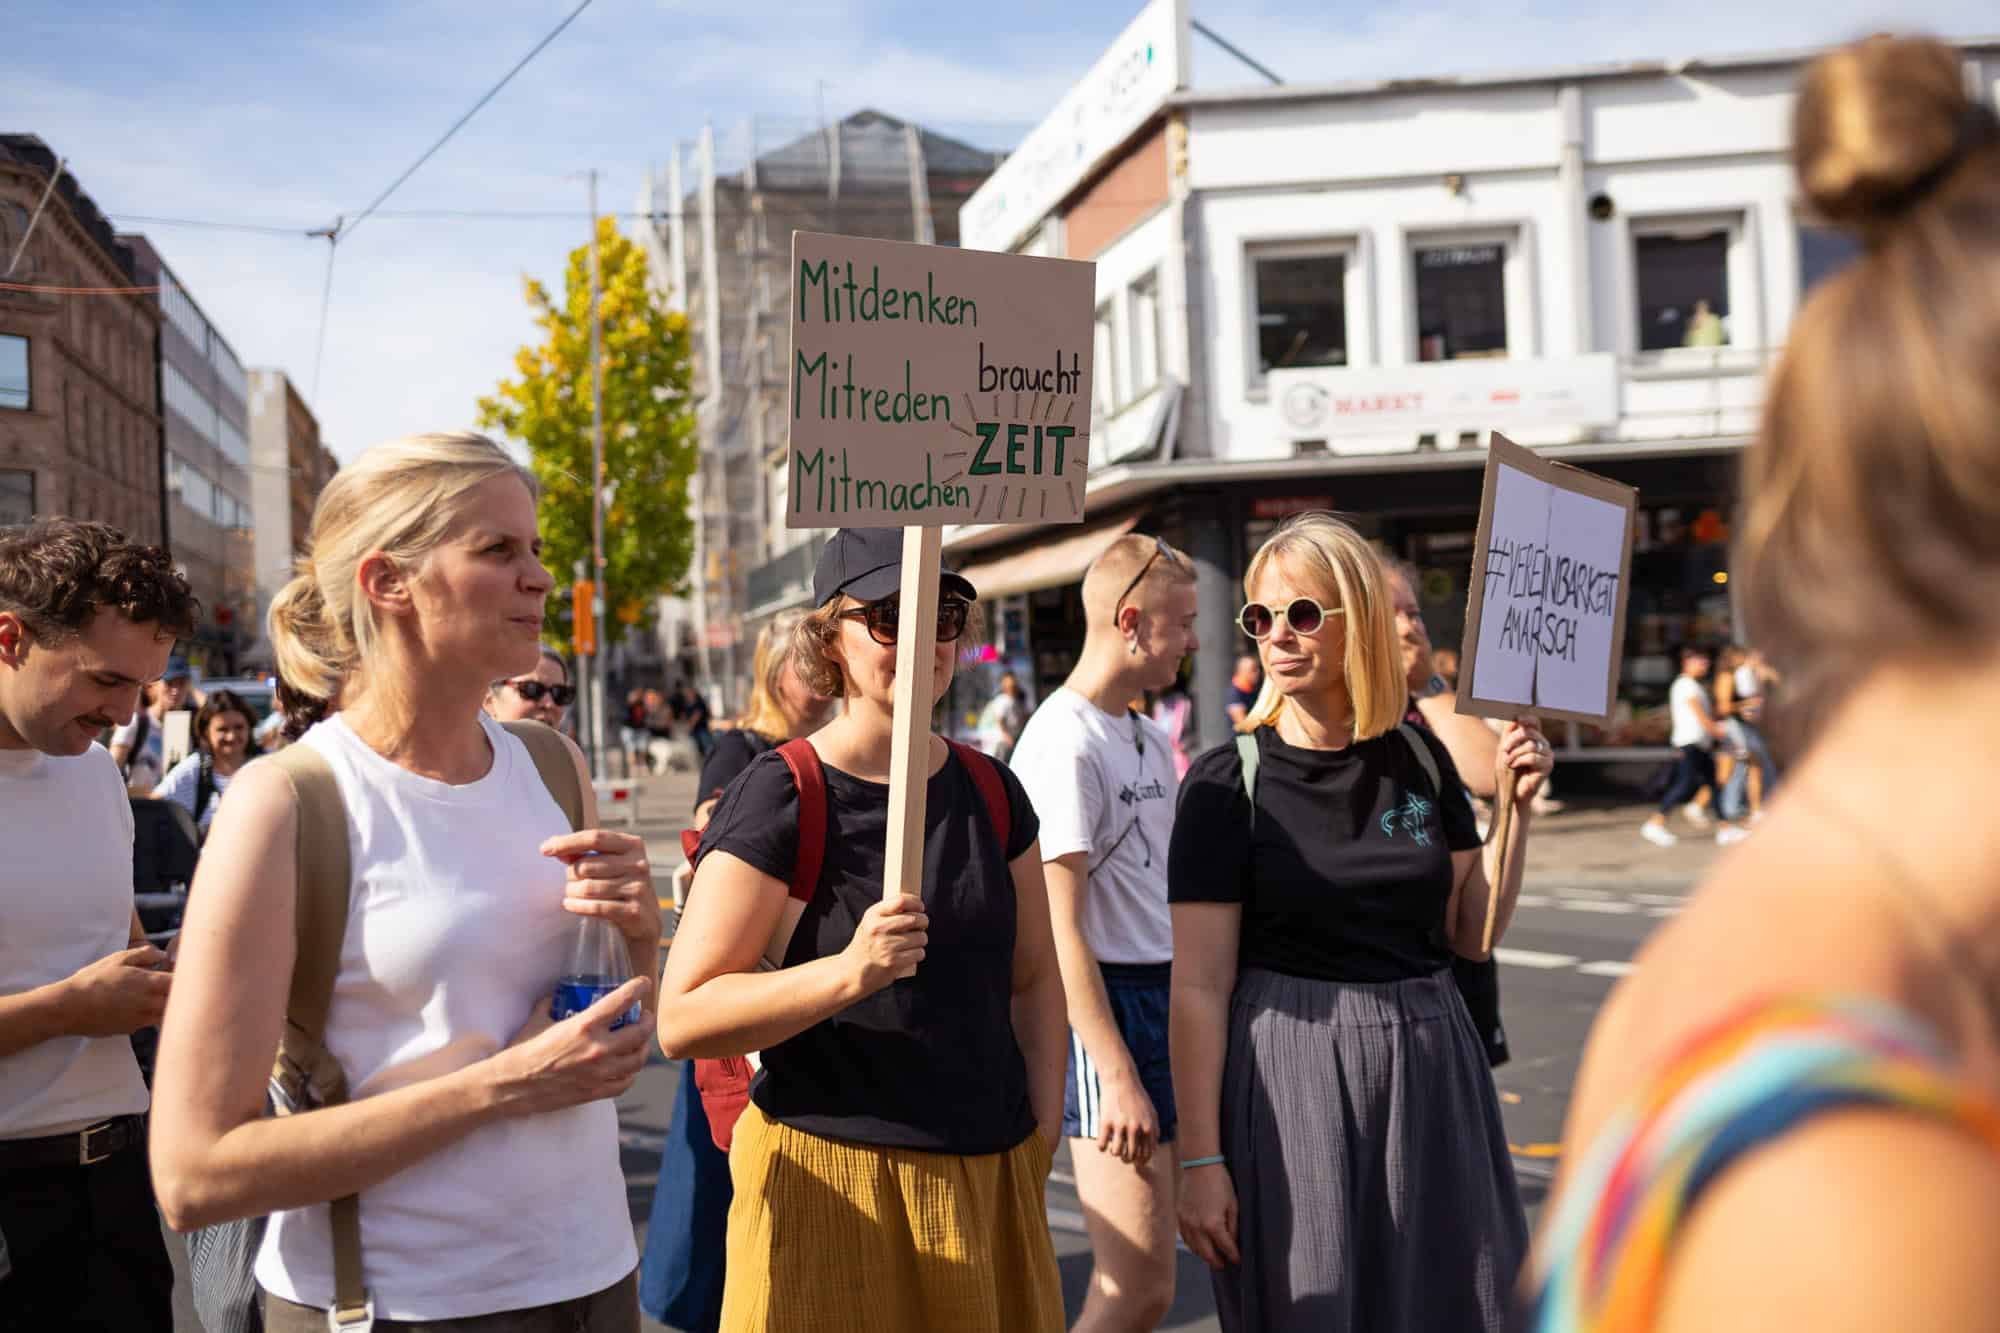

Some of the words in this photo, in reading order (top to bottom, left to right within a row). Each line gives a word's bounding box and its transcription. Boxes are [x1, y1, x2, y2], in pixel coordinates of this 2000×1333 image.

[801, 259, 977, 327] Mitdenken
[795, 348, 951, 423] Mitreden
[978, 341, 1081, 395] braucht
[795, 447, 971, 513] Mitmachen
[968, 422, 1075, 476] ZEIT
